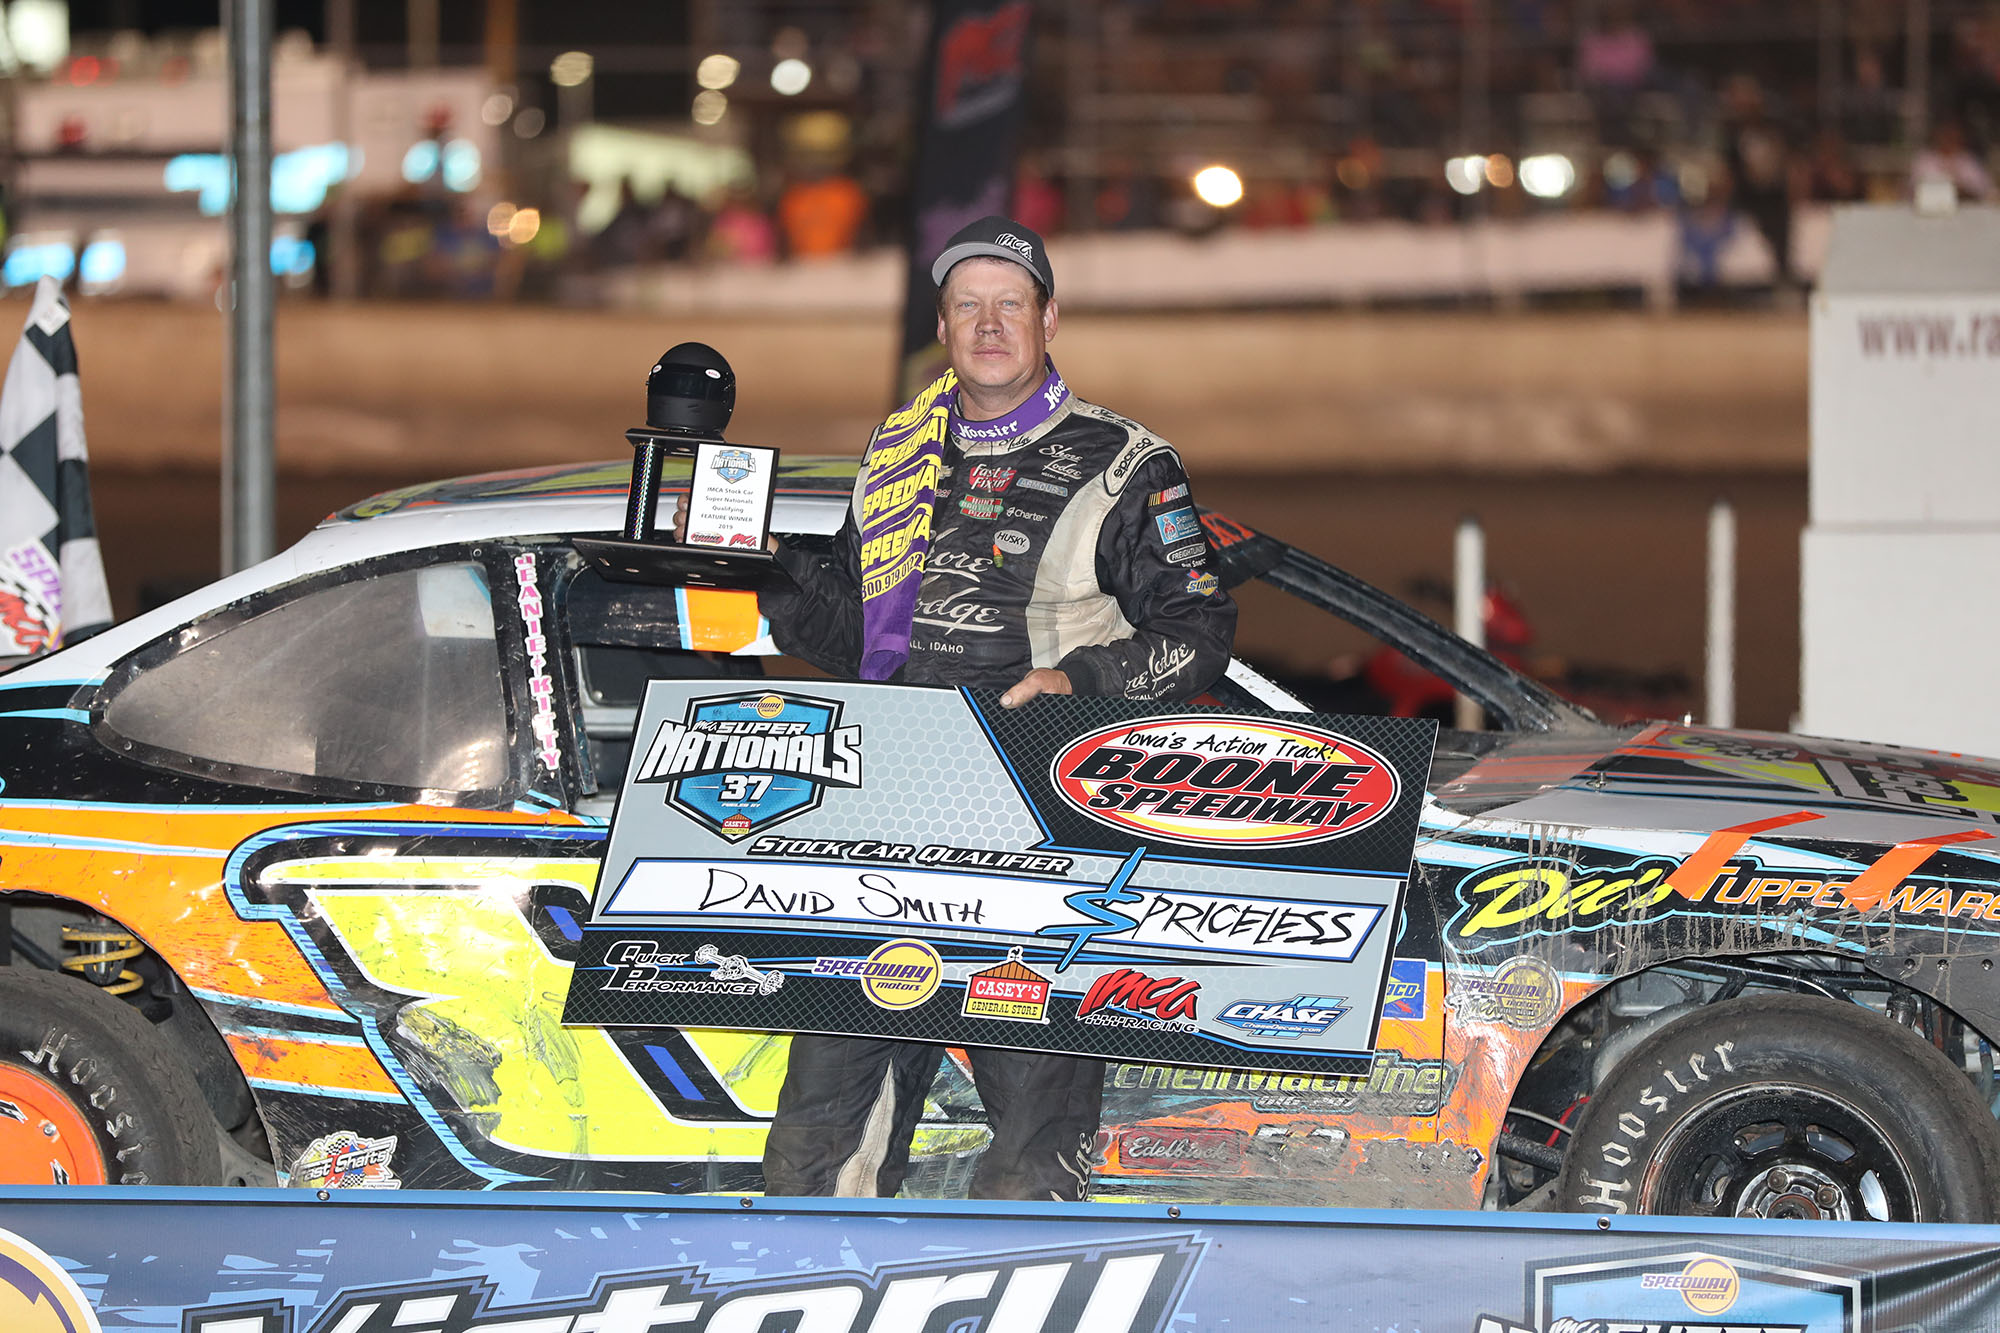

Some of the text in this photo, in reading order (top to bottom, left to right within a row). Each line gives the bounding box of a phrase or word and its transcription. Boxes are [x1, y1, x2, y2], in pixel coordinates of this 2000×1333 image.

[957, 420, 1018, 440] Hoosier
[973, 463, 1001, 478] Fast
[712, 505, 744, 513] Qualifying
[967, 508, 992, 517] PIZZA
[1014, 509, 1044, 521] Charter
[996, 532, 1027, 546] HUSKY
[515, 553, 548, 652] JEANIE
[929, 642, 964, 653] IDAHO
[1155, 682, 1176, 697] IDAHO
[717, 721, 811, 735] SUPER
[636, 719, 863, 787] NATIONALS
[1122, 729, 1340, 761] Iowa's Action Track!
[1066, 748, 1376, 798] BOONE
[719, 774, 774, 801] 37
[1089, 783, 1374, 828] SPEEDWAY
[724, 820, 749, 828] CASEY'S
[752, 837, 1070, 873] STOCK CAR QUALIFIER
[699, 868, 986, 925] DAVID SMITH
[1688, 866, 2000, 922] TUPPEWARE
[1131, 893, 1356, 946] PRICELESS
[603, 940, 691, 967] QUICK
[815, 957, 936, 984] SPEEDWAY
[600, 966, 760, 996] PERFORMANCE
[876, 982, 922, 992] motors
[974, 982, 1042, 1000] CASEY'S
[971, 1000, 1040, 1017] GENERAL STORE
[1221, 1003, 1340, 1025] CHASE
[1126, 1018, 1196, 1034] RACING
[1241, 1022, 1322, 1034] ChaseDecals.com
[334, 1144, 391, 1174] Shafts
[1640, 1271, 1734, 1292] SPEEDWAY
[1691, 1293, 1728, 1301] motors
